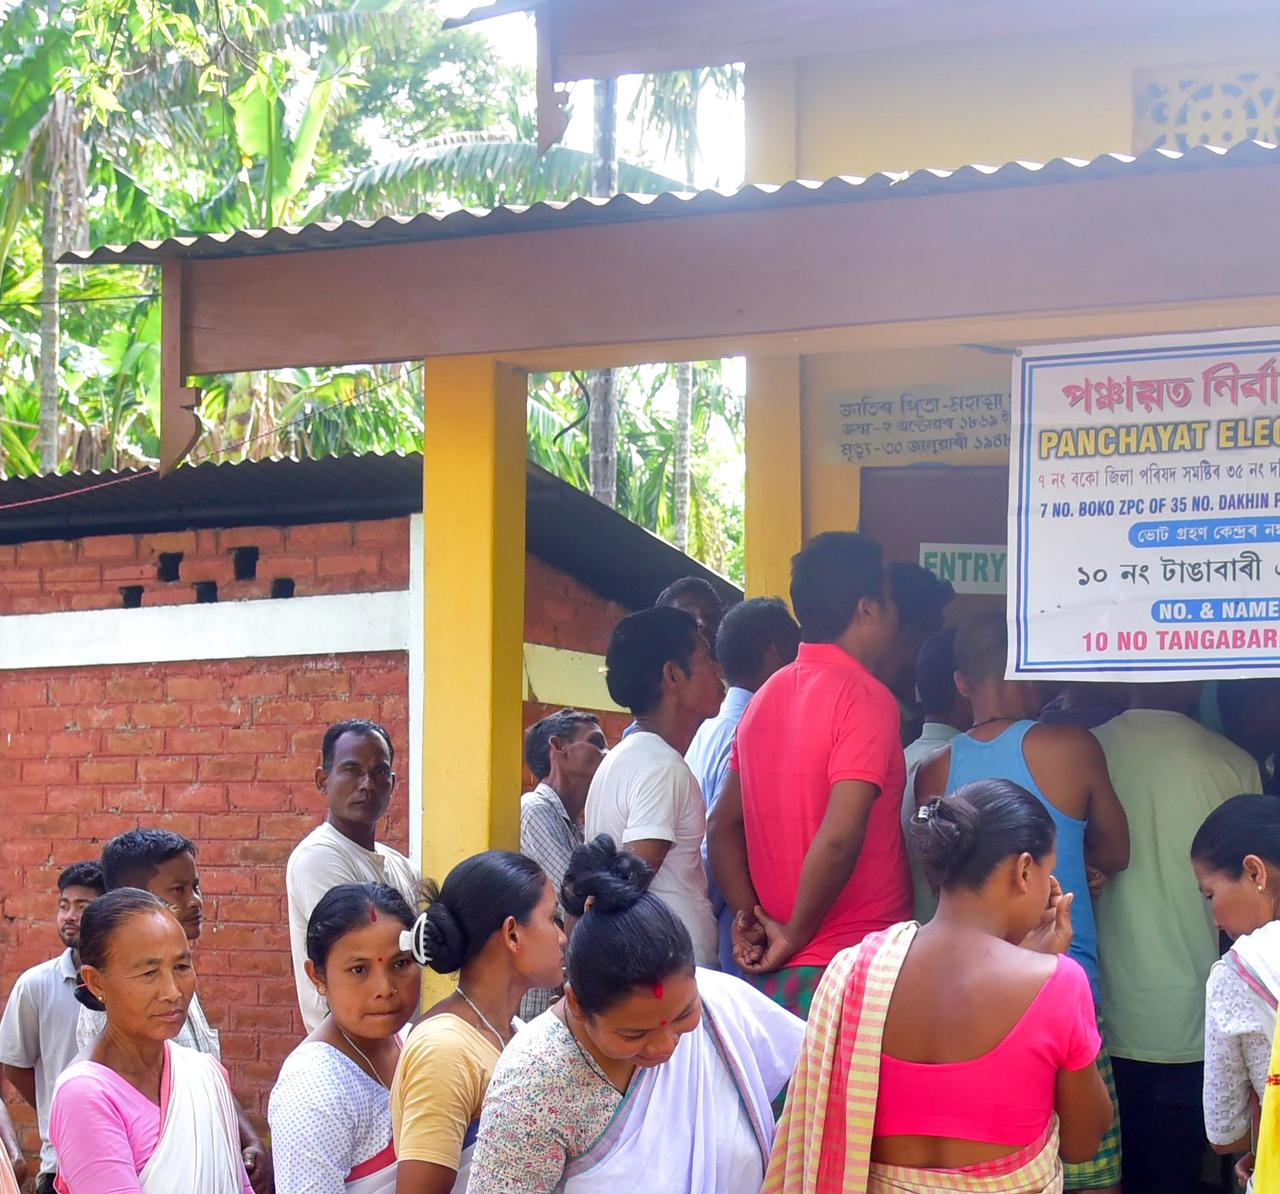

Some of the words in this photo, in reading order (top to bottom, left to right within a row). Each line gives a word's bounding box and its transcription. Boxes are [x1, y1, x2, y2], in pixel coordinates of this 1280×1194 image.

[1061, 375, 1195, 415] পঞ্চায়ত
[1038, 421, 1211, 459] PANCHAYAT
[1050, 472, 1067, 488] নং
[1071, 470, 1100, 488] বকো
[1104, 464, 1135, 487] জিলা
[1226, 465, 1244, 480] ৩৫
[1249, 462, 1266, 479] নং
[1039, 503, 1048, 518] 7
[1051, 501, 1074, 518] NO.
[1078, 499, 1115, 517] BOKO
[1118, 498, 1145, 516] ZPC
[1148, 497, 1166, 514] OF
[1170, 496, 1188, 513] 35
[1191, 494, 1214, 512] NO.
[1218, 492, 1269, 511] DAKHIN
[1137, 526, 1170, 544] ভোট
[1077, 566, 1108, 586] ১০
[1120, 562, 1150, 585] নং
[1158, 603, 1193, 620] NO.
[1199, 602, 1215, 619] &
[1221, 601, 1280, 618] NAME
[1082, 632, 1109, 652] 10
[1117, 631, 1148, 651] NO
